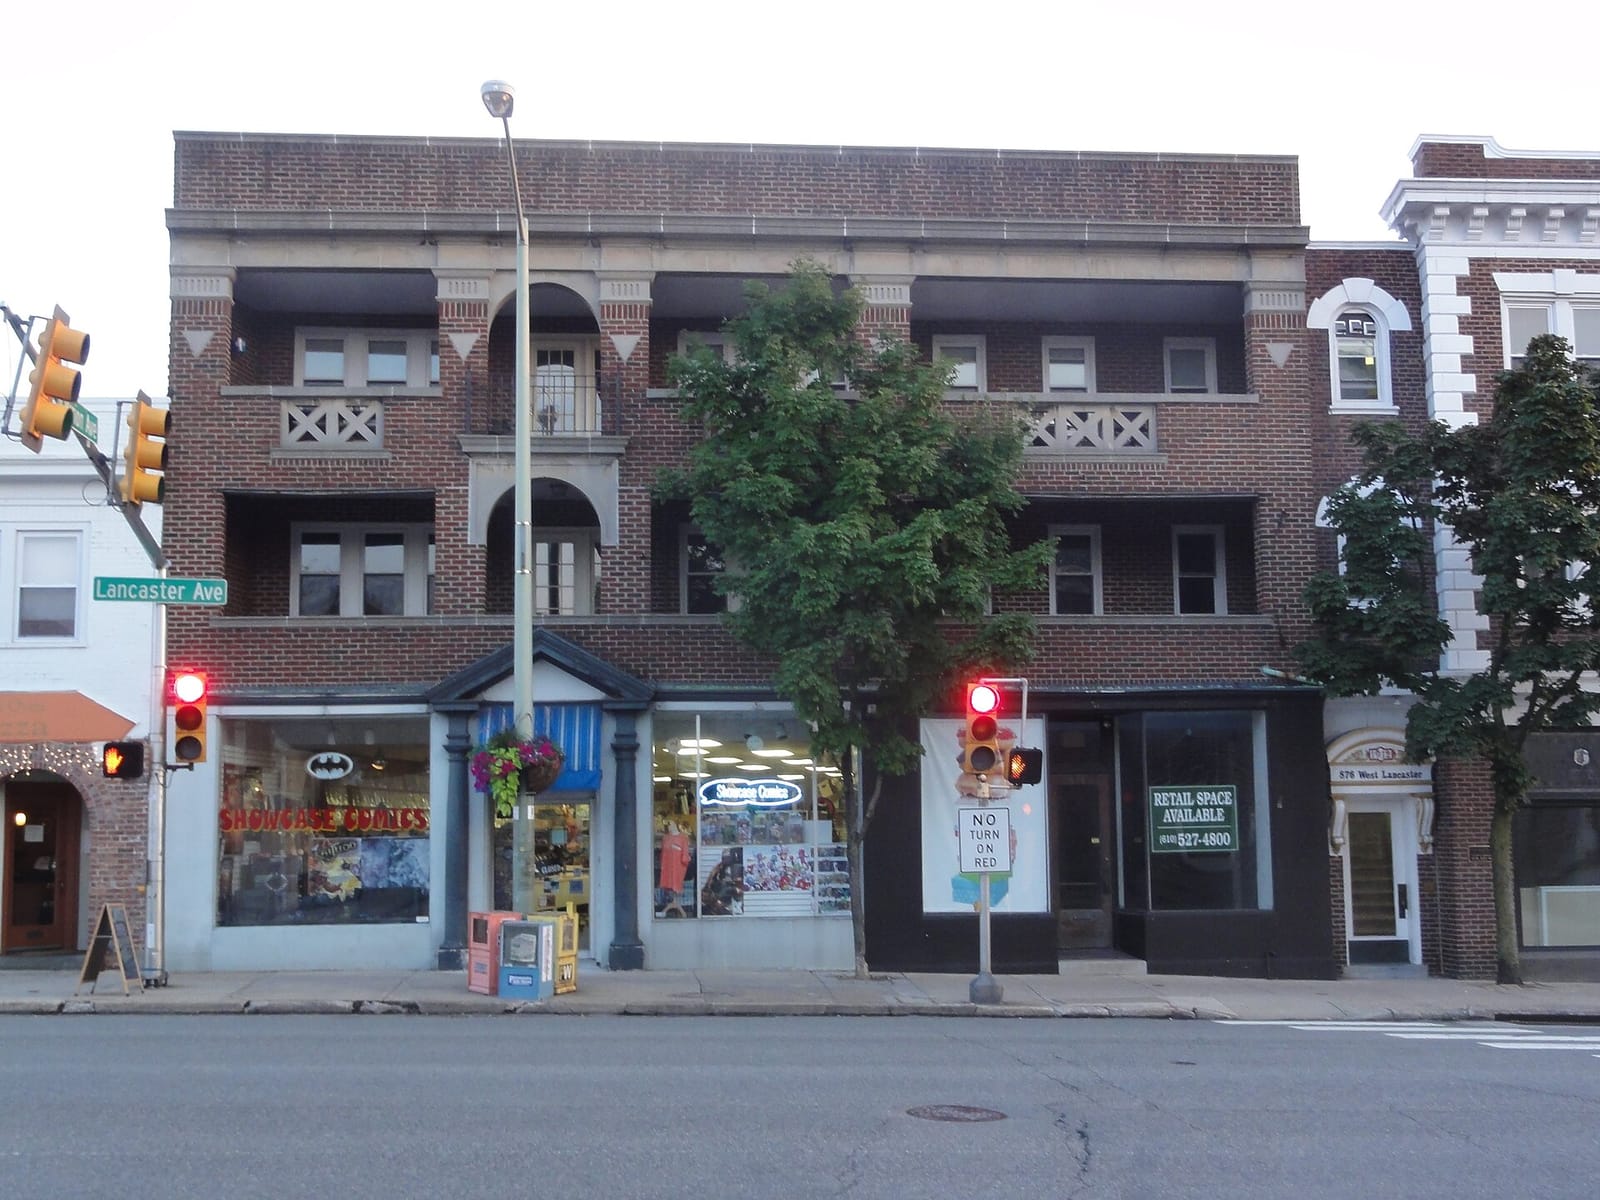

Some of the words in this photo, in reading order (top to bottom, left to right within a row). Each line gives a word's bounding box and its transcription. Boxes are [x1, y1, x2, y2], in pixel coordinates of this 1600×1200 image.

[96, 579, 186, 600] Lancaster
[192, 582, 224, 601] Ave
[1358, 770, 1379, 779] West
[1381, 770, 1423, 779] Lancaster
[1153, 792, 1195, 807] RETAIL
[1196, 791, 1233, 806] SPACE
[219, 807, 337, 832] SHOWCASE
[344, 807, 429, 832] COMICS
[972, 814, 996, 826] NO
[1163, 807, 1225, 823] AVAILABLE
[970, 829, 1000, 840] TURN
[1177, 832, 1231, 847] 527-4800
[976, 843, 994, 854] ON
[974, 857, 997, 868] RED
